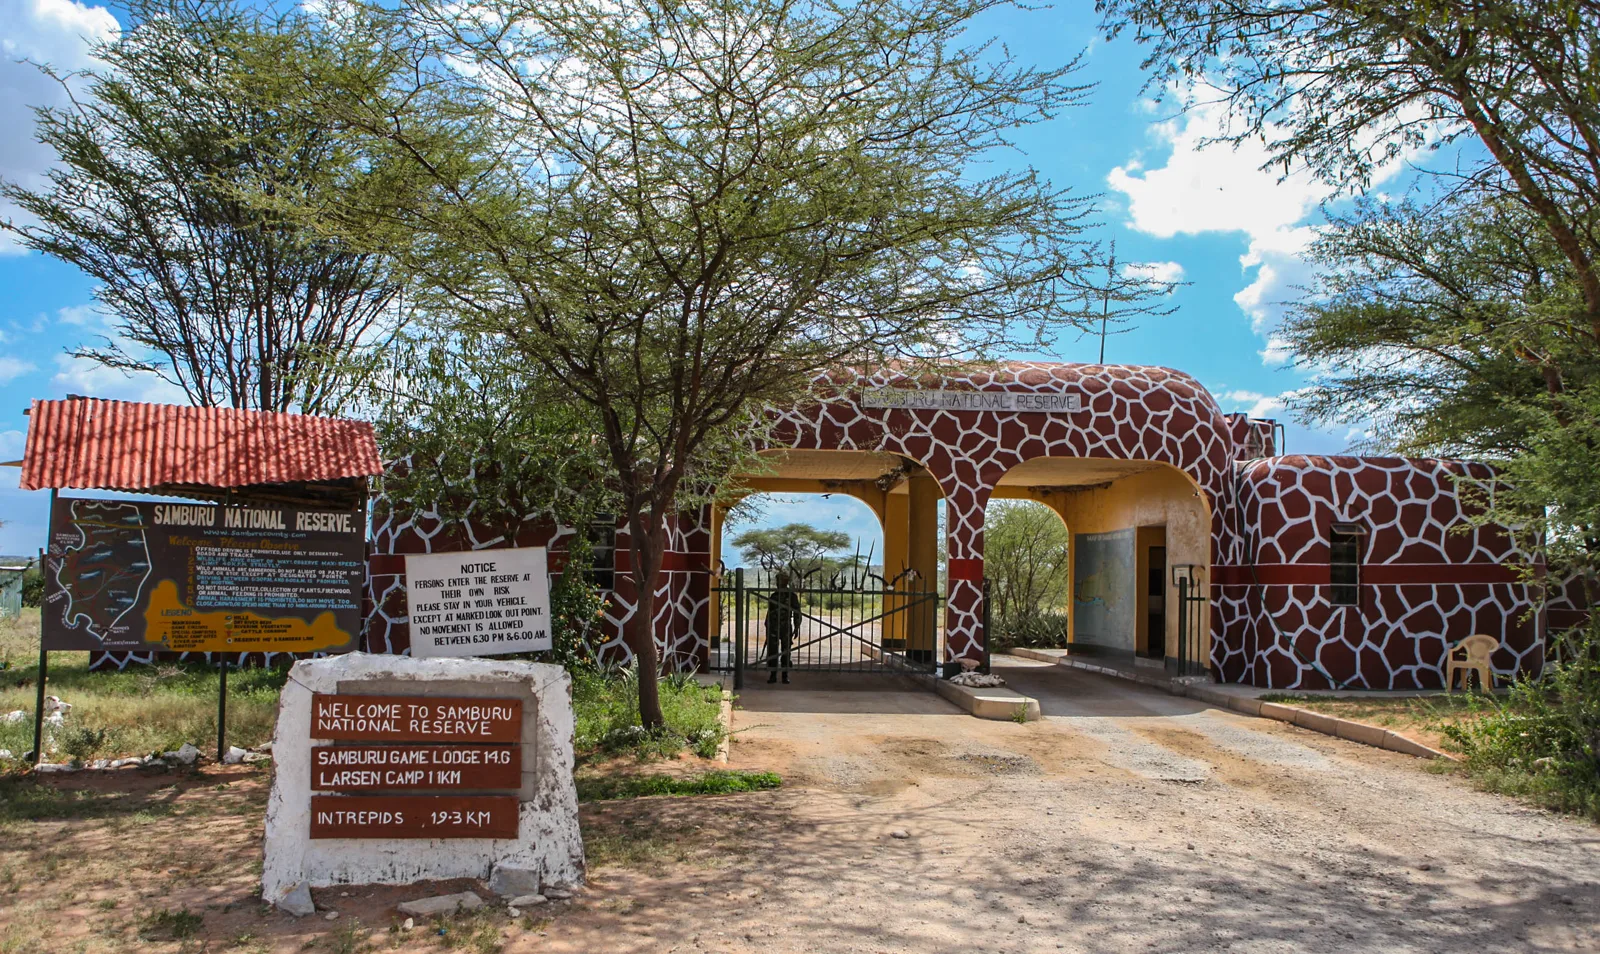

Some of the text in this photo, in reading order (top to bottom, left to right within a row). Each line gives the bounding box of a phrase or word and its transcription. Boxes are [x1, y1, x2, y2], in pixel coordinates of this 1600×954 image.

[868, 391, 1075, 410] SBURU NATIONAL RESERVE
[154, 505, 356, 533] SAMBURU NATIONAL RESERVE.
[220, 537, 257, 548] Please
[461, 562, 497, 574] NOTICE
[415, 573, 531, 589] PERSONS ENTER THE RESERVE AT
[441, 586, 511, 599] THEIR OWN RISK
[416, 602, 441, 612] PLEASE
[444, 601, 460, 611] STAY
[463, 600, 471, 609] IN
[474, 598, 493, 608] YOUR
[413, 607, 544, 624] EXCEPT AT MARKED LOOK OUT POINT.
[420, 620, 523, 635] NO MOVEMENT IS ALLOWED
[435, 635, 471, 646] BETWEEN
[473, 634, 490, 643] 6.30
[492, 633, 504, 642] PM
[319, 703, 513, 721] WELCOME TO SAMBURU
[319, 719, 492, 735] NATIONAL RESERVE
[318, 751, 387, 765] SAMBURU
[389, 750, 430, 764] GAME
[433, 750, 481, 764] LODGE
[320, 771, 381, 786] LARSEN
[386, 770, 424, 785] CAMP
[318, 811, 404, 825] INTREPIDS
[467, 811, 491, 828] KM
